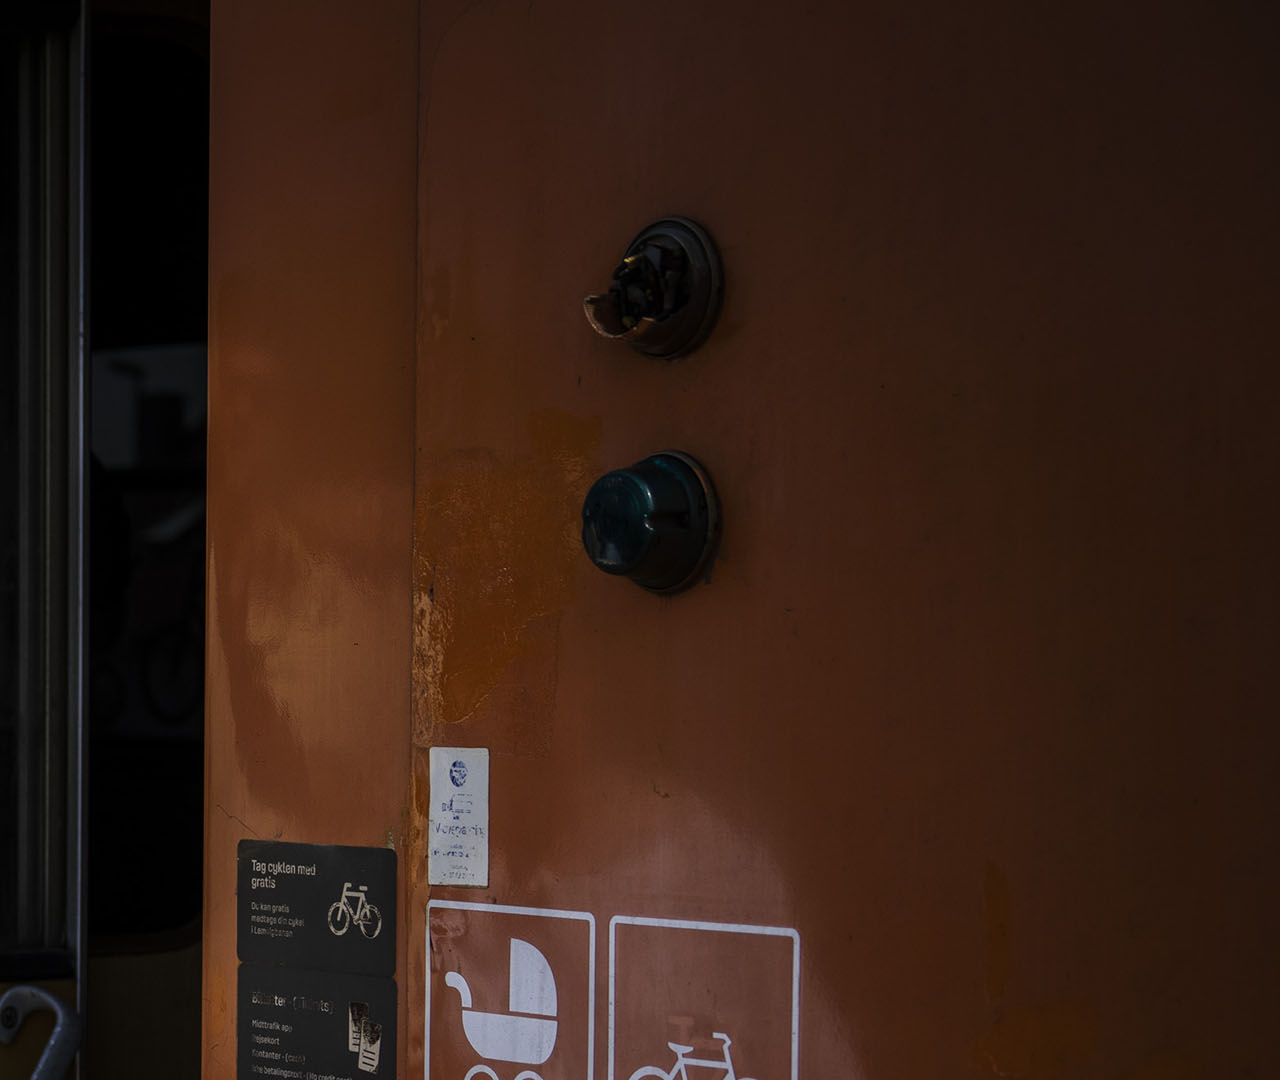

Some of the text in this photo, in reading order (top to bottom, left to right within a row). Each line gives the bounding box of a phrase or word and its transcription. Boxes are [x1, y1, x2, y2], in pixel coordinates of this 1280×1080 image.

[251, 859, 316, 876] Tag cyklen med
[251, 876, 276, 889] gratis
[272, 904, 290, 913] gratis
[251, 1033, 280, 1045] ejsekort
